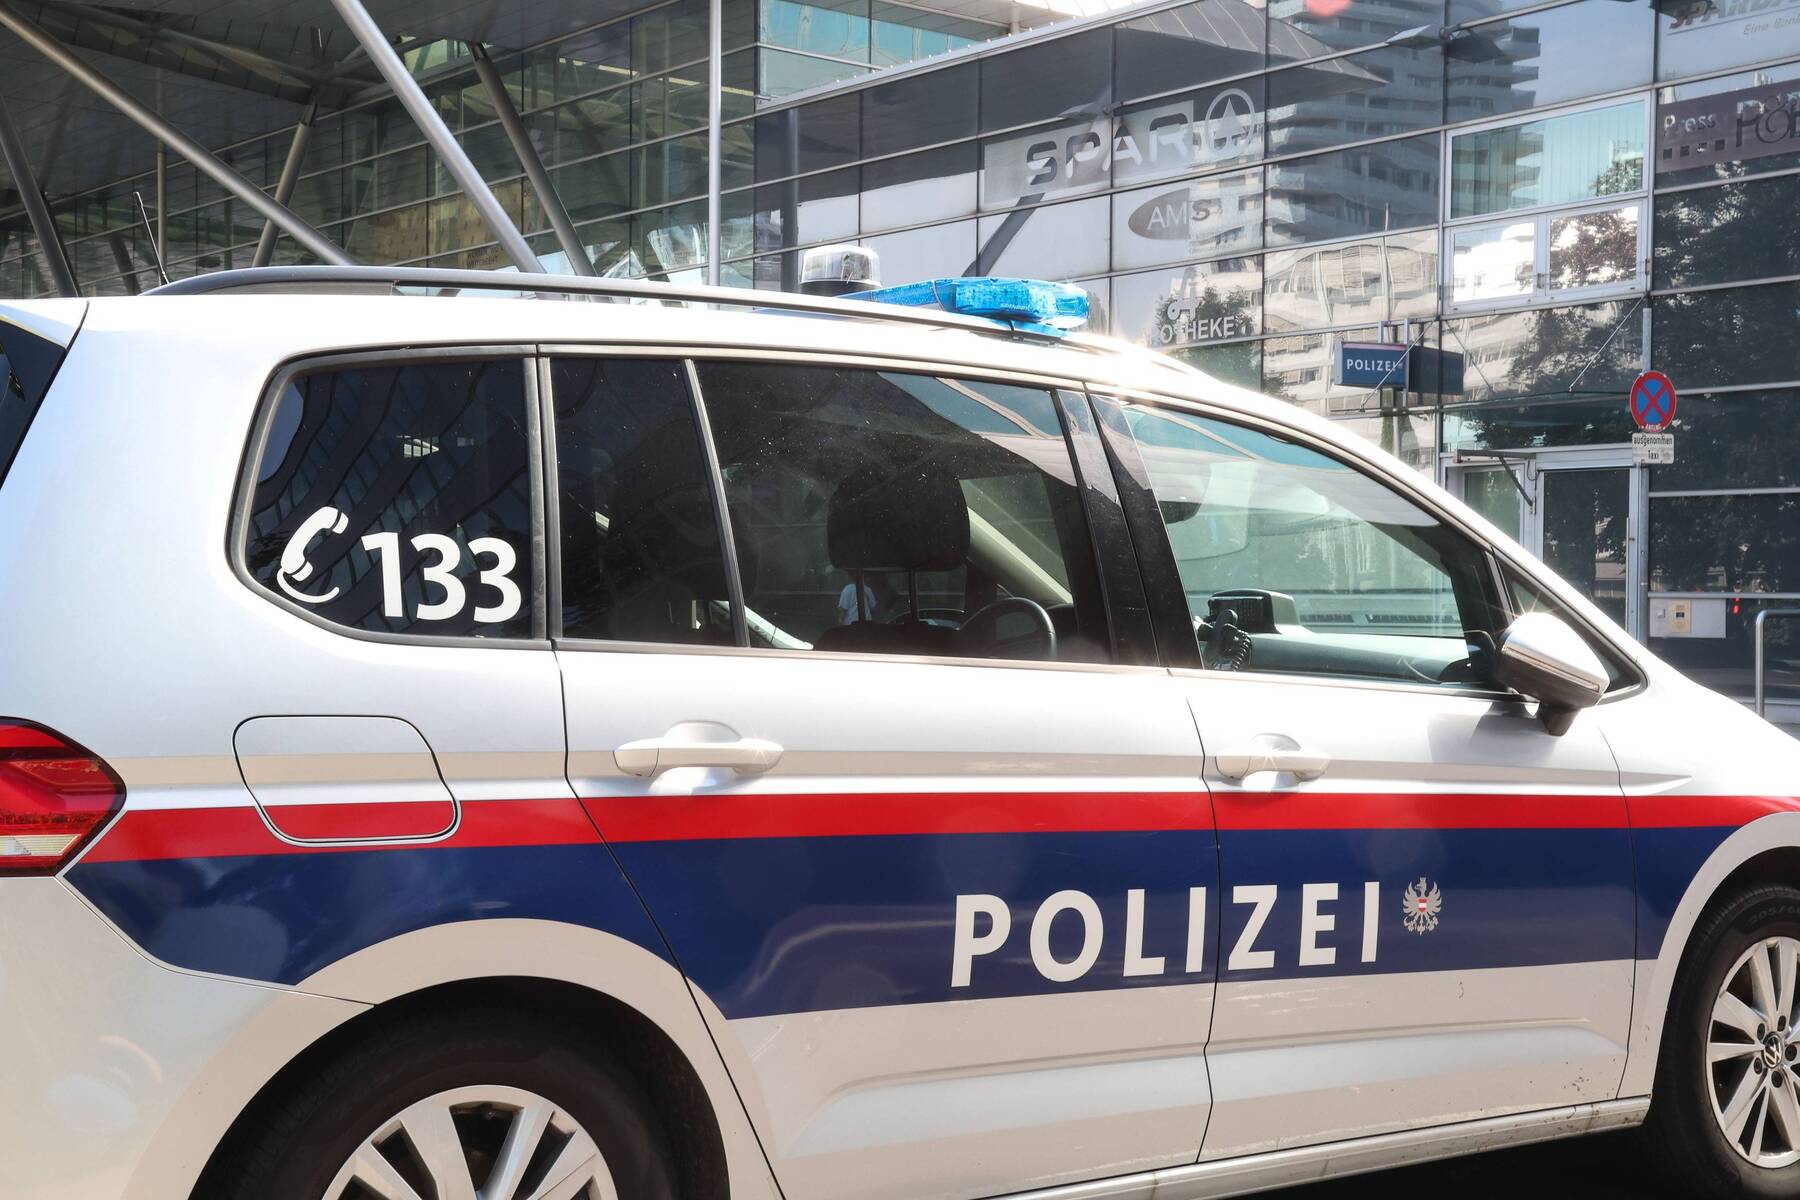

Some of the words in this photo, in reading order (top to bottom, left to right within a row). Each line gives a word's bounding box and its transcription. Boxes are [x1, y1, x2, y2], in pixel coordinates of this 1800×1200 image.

[1663, 113, 1717, 138] Press
[1026, 112, 1190, 186] SPAR
[1147, 199, 1211, 230] AMS
[1633, 435, 1673, 447] ausgenommen
[1648, 450, 1659, 460] Taxi
[361, 531, 522, 623] 133
[951, 881, 1380, 988] POLIZEI
